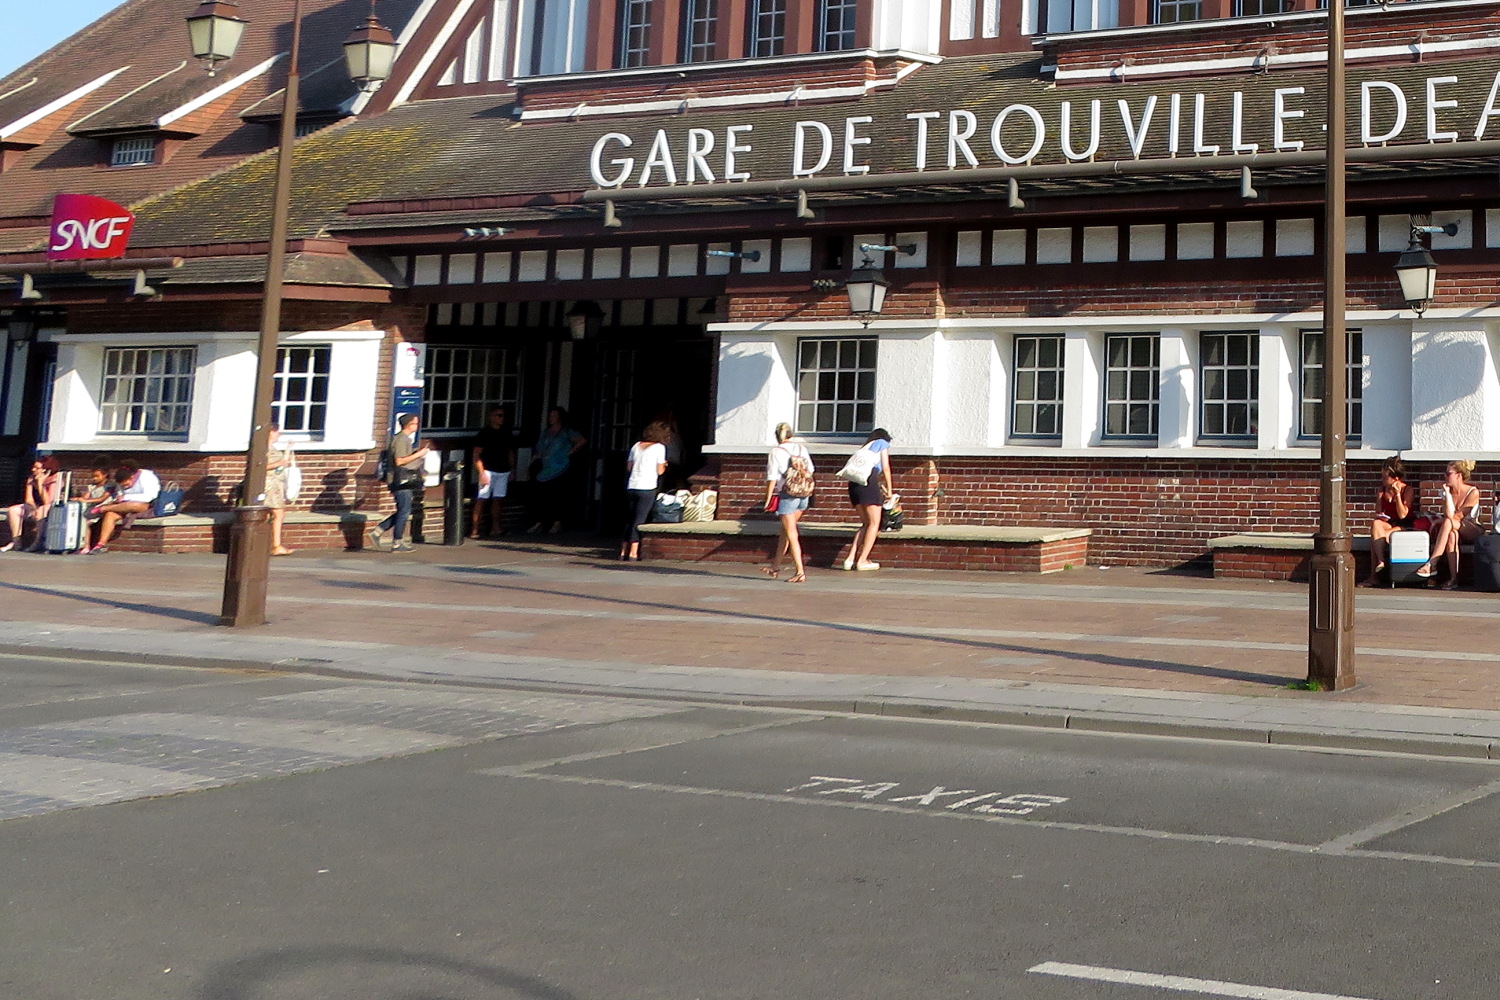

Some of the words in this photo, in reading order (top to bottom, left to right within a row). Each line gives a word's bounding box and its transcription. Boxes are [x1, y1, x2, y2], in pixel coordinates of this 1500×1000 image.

[590, 124, 753, 189] GARE
[793, 115, 873, 177] DE
[907, 86, 1305, 172] TROUVILLE
[51, 216, 131, 251] SNCF
[787, 775, 1070, 816] TAXIS
